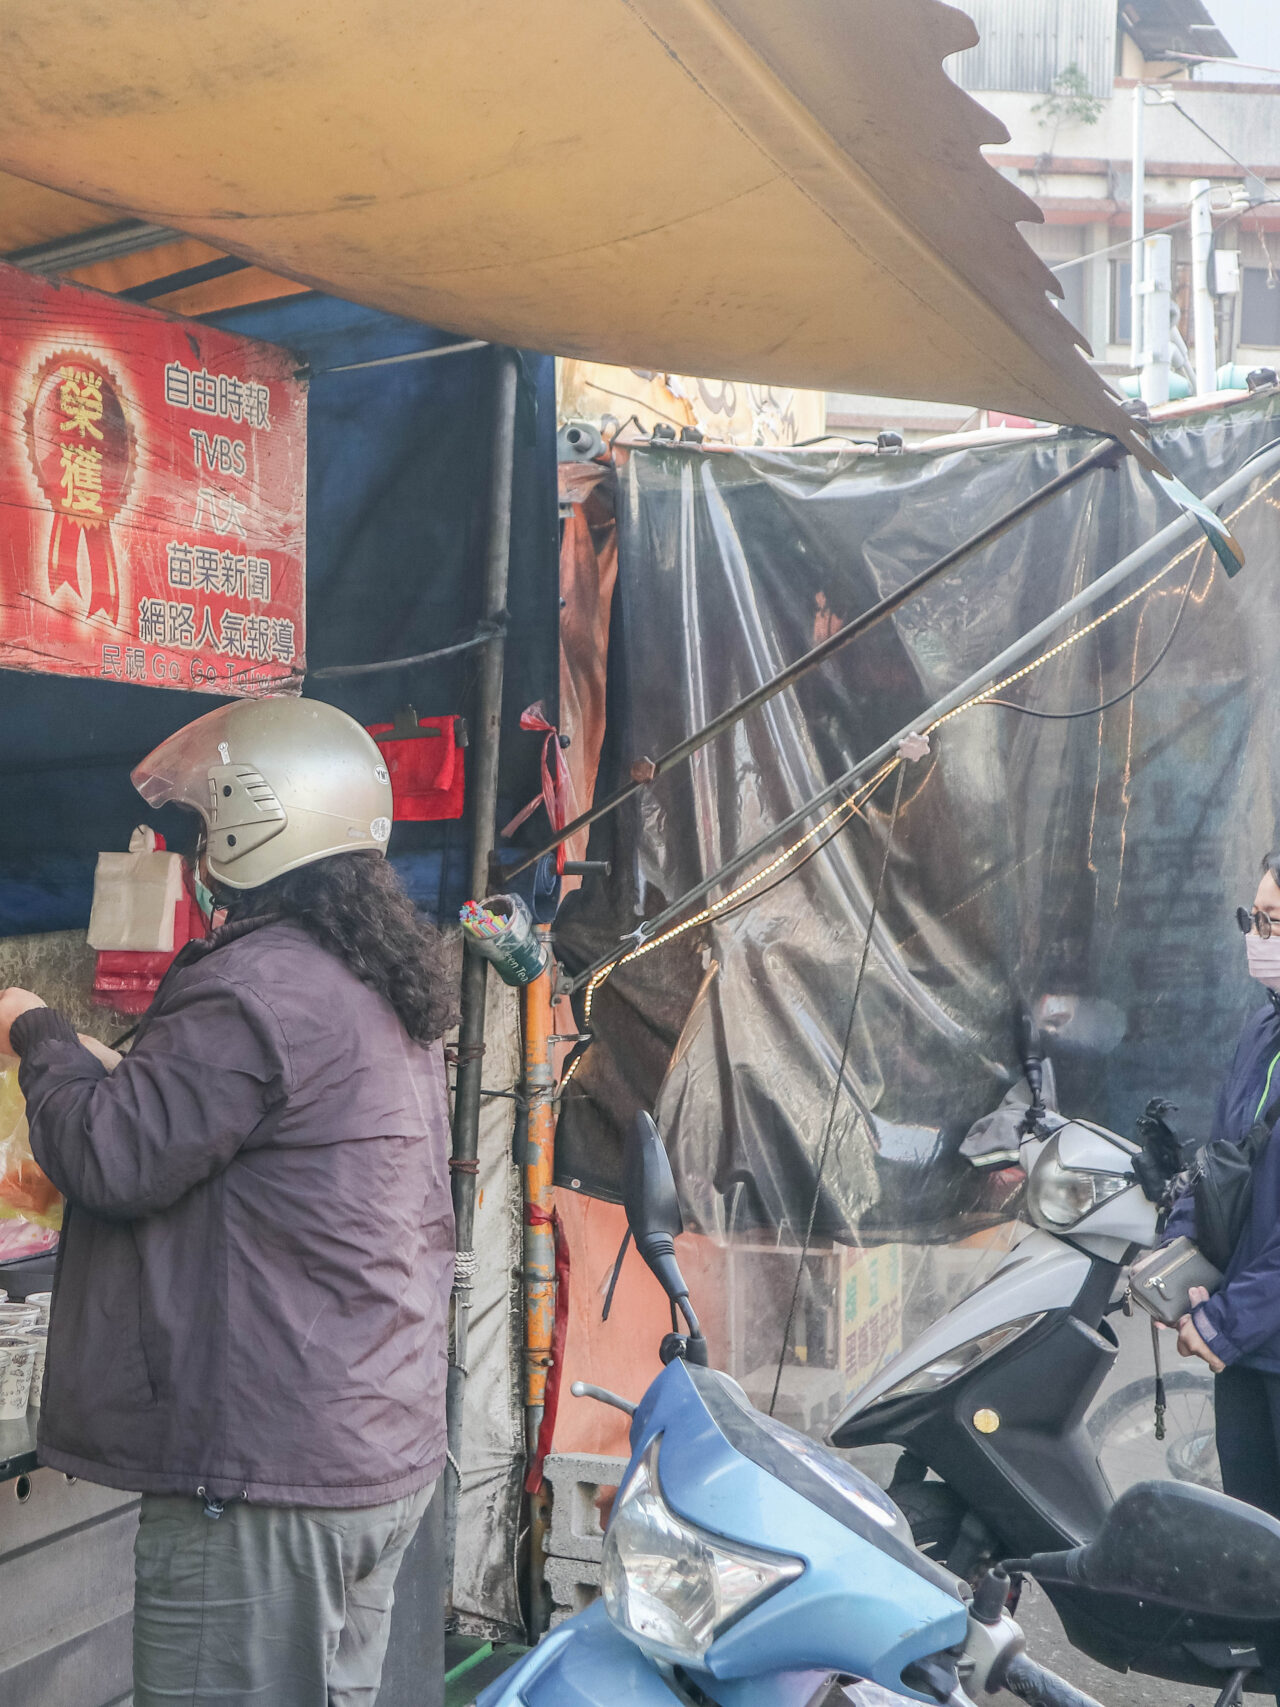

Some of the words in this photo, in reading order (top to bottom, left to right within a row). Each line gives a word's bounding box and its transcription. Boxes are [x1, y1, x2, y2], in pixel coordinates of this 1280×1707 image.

[164, 360, 271, 432] 自由時報
[59, 366, 104, 514] 榮獲
[190, 430, 246, 476] TVBS
[192, 488, 248, 540] 八大
[166, 540, 271, 602] 苗栗新聞
[138, 596, 296, 664] 網路人氣報導
[101, 643, 147, 680] 民視
[152, 653, 180, 680] Go
[516, 966, 529, 982] Tea
